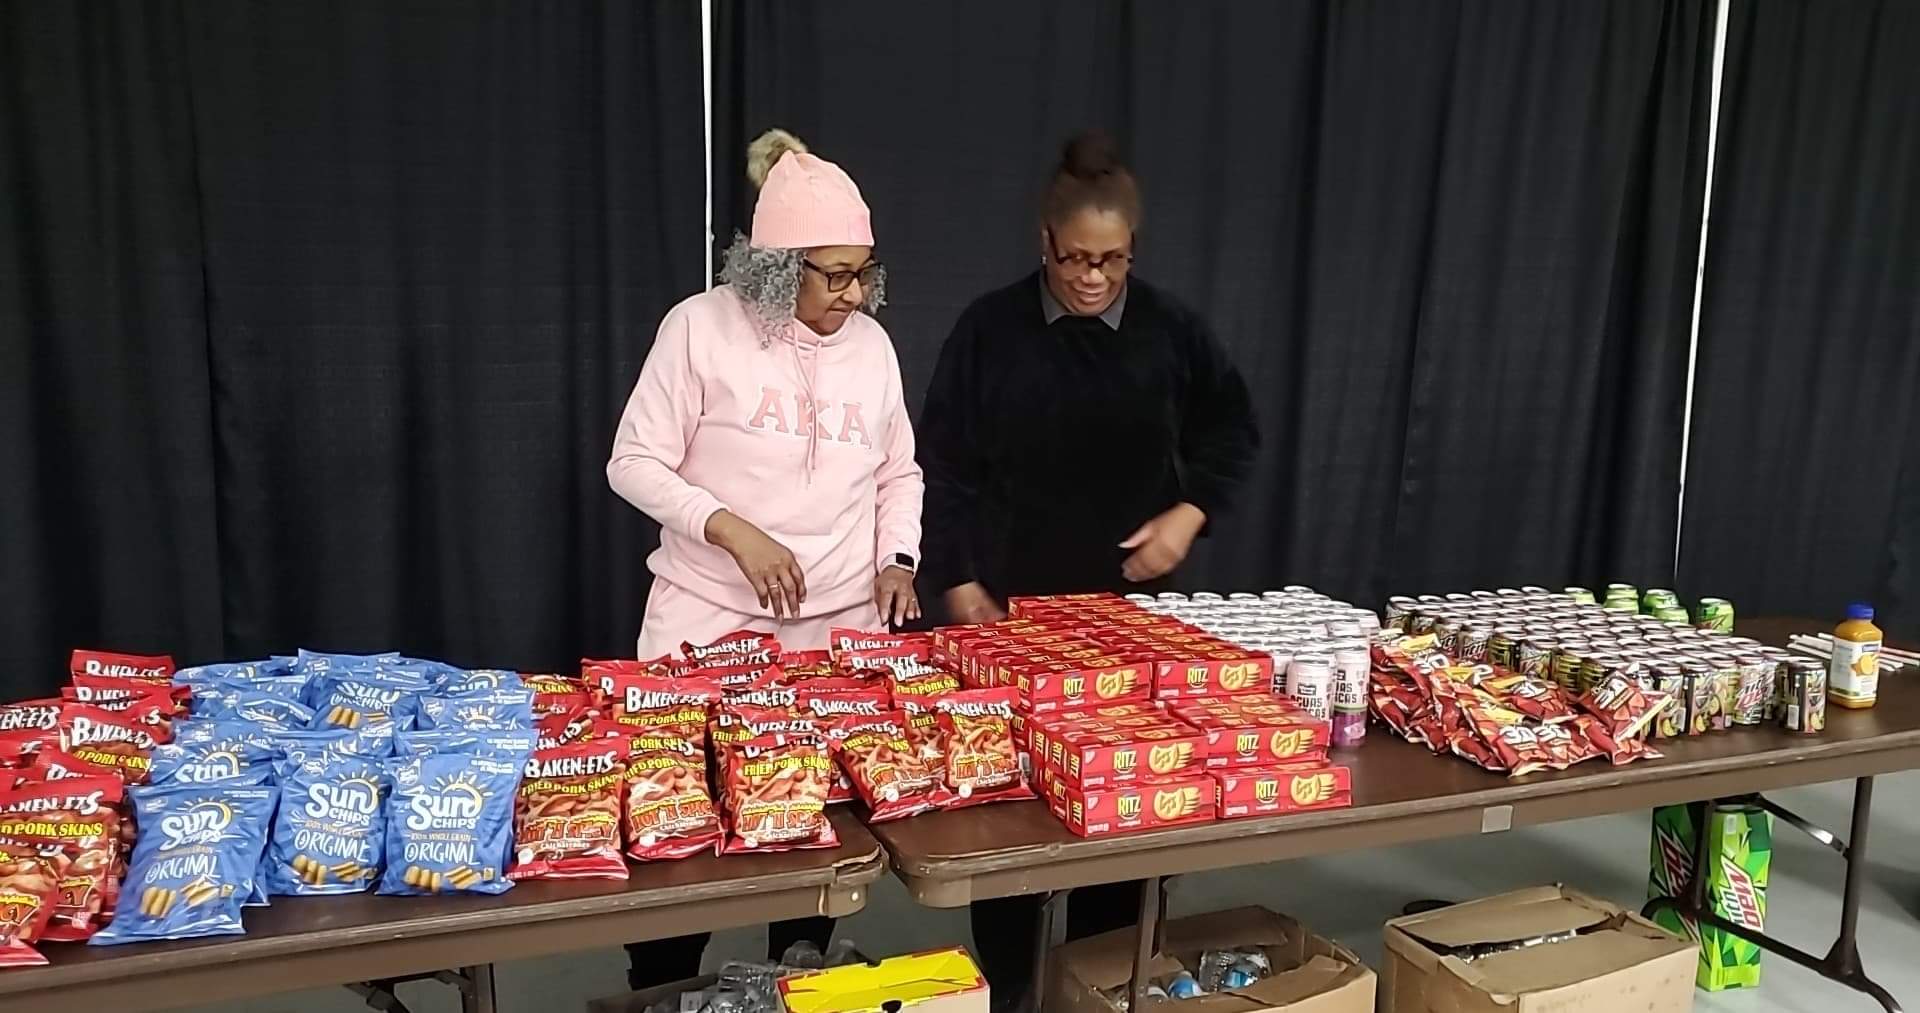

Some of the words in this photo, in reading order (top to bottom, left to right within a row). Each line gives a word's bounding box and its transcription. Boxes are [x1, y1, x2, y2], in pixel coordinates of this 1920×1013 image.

[749, 386, 874, 449] AKA
[1063, 677, 1085, 697] RITZ
[1187, 666, 1210, 687] RITZ
[1236, 734, 1261, 755] RITZ
[523, 750, 618, 778] BAKEN-ETS
[1113, 750, 1138, 772] RITZ
[305, 778, 380, 819] Sun
[554, 782, 588, 795] PORK
[1255, 779, 1280, 802] RITZ
[328, 806, 371, 827] CHIPS
[406, 782, 483, 831] Sun
[1072, 801, 1083, 827] RITZ
[1117, 795, 1143, 818] RITZ
[13, 822, 58, 836] PORK
[58, 822, 104, 837] SKINS
[159, 801, 232, 852] Sun
[431, 817, 477, 830] CHIPS
[293, 828, 371, 863] ORIGINAL
[403, 841, 482, 866] ORIGINAL
[144, 853, 222, 885] ORIGINAL
